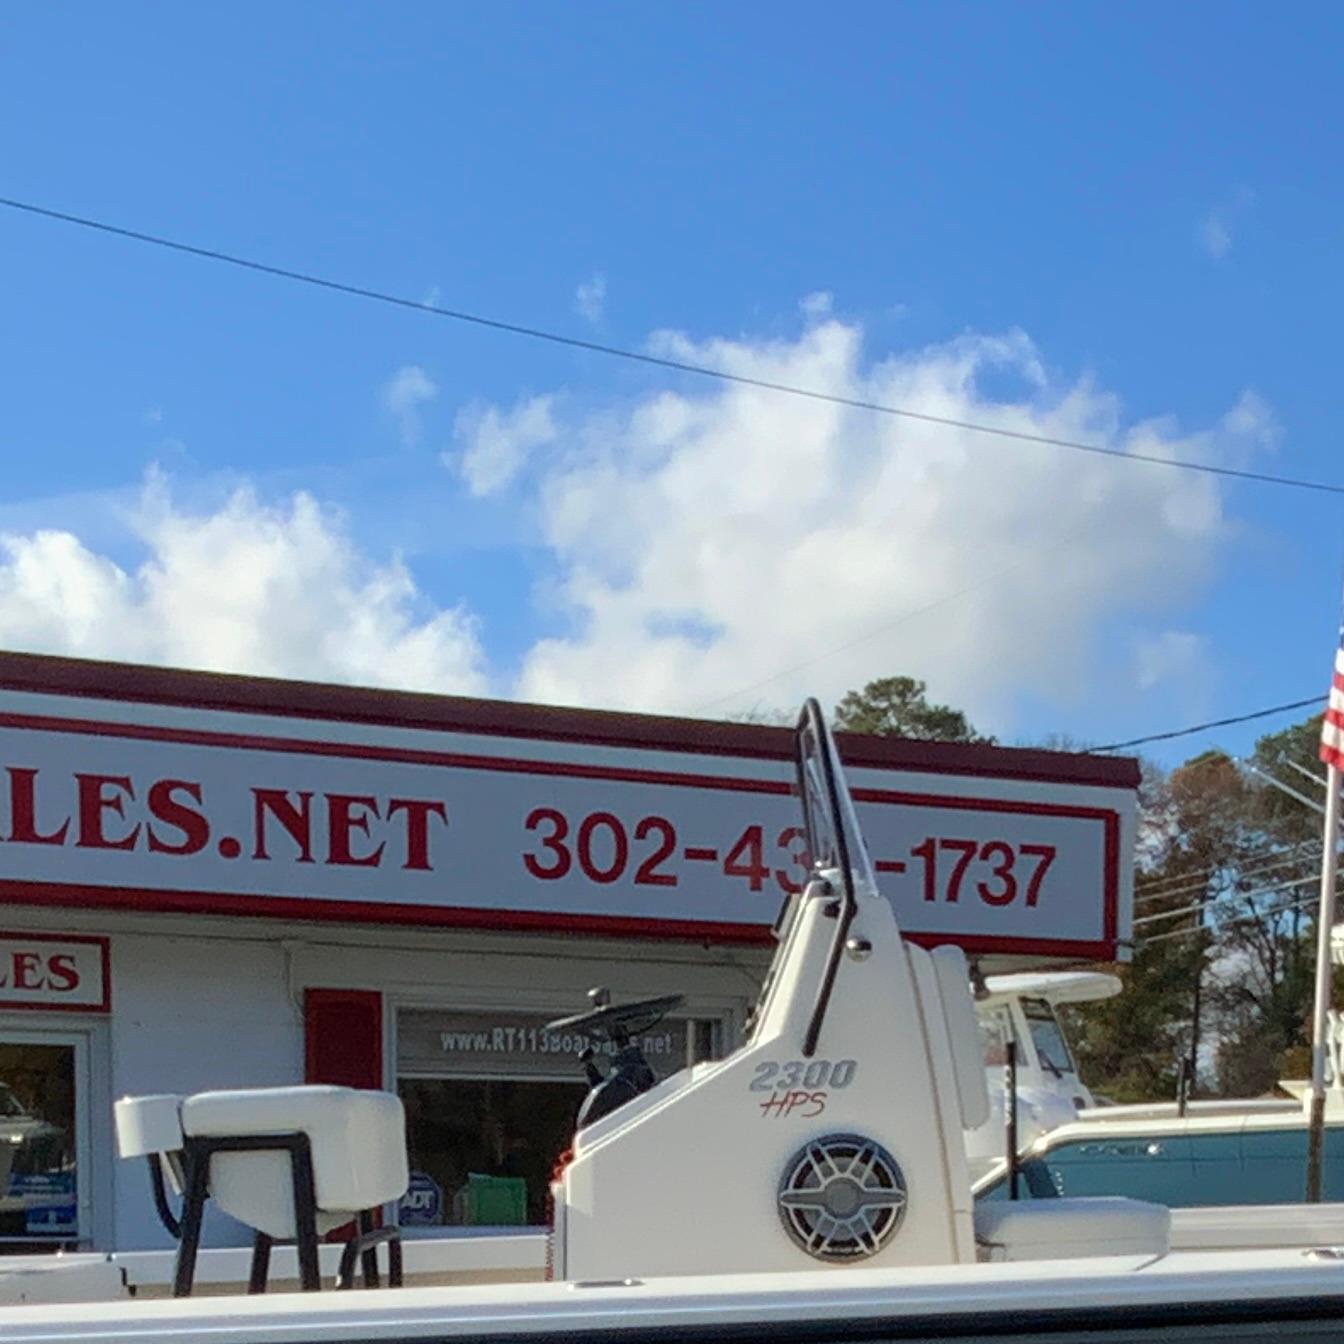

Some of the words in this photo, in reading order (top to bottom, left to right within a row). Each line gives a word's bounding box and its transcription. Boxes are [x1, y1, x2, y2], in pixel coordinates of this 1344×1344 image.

[523, 807, 1057, 908] 302-43-1737
[749, 1059, 858, 1092] 2300
[760, 1090, 828, 1118] HPS
[399, 1189, 434, 1210] ADT
